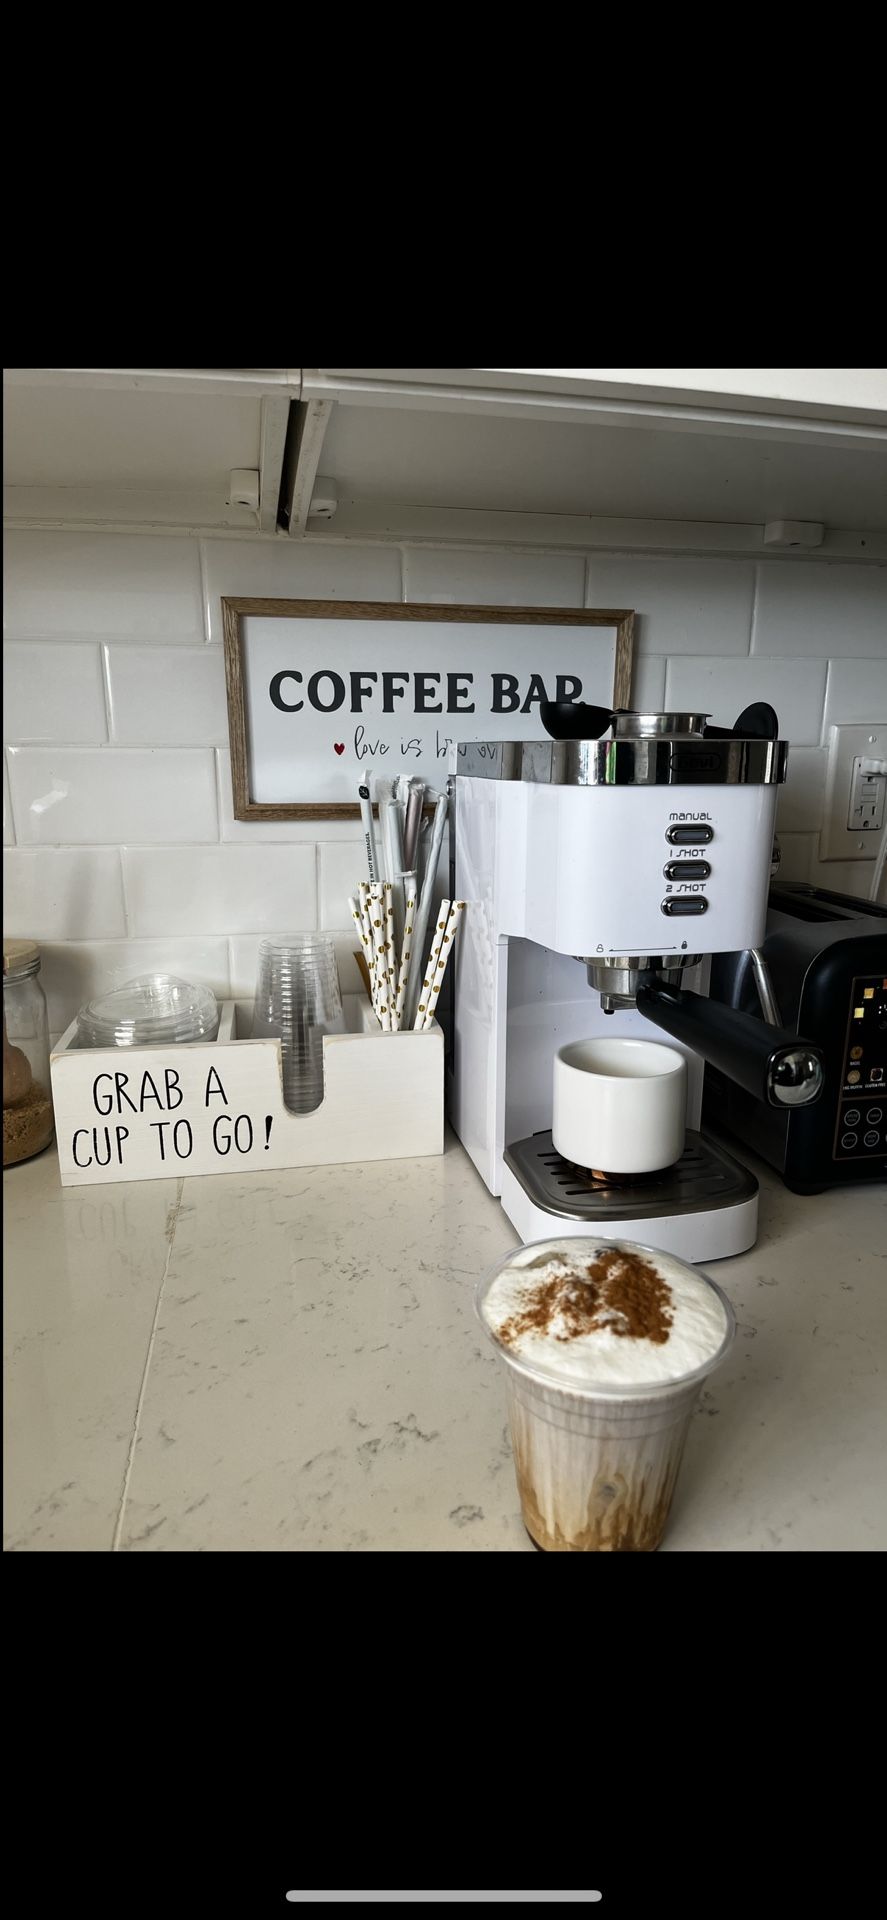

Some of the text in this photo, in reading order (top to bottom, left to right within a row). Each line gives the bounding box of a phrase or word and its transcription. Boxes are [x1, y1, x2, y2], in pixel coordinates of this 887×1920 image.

[269, 670, 584, 714] COFFEE BAR
[354, 725, 390, 761] love
[400, 738, 423, 759] is
[669, 848, 707, 858] 1 SHOT
[665, 883, 707, 893] 2 SHOT
[92, 1065, 229, 1116] GRAB A
[72, 1114, 273, 1168] CUP TO GO!
